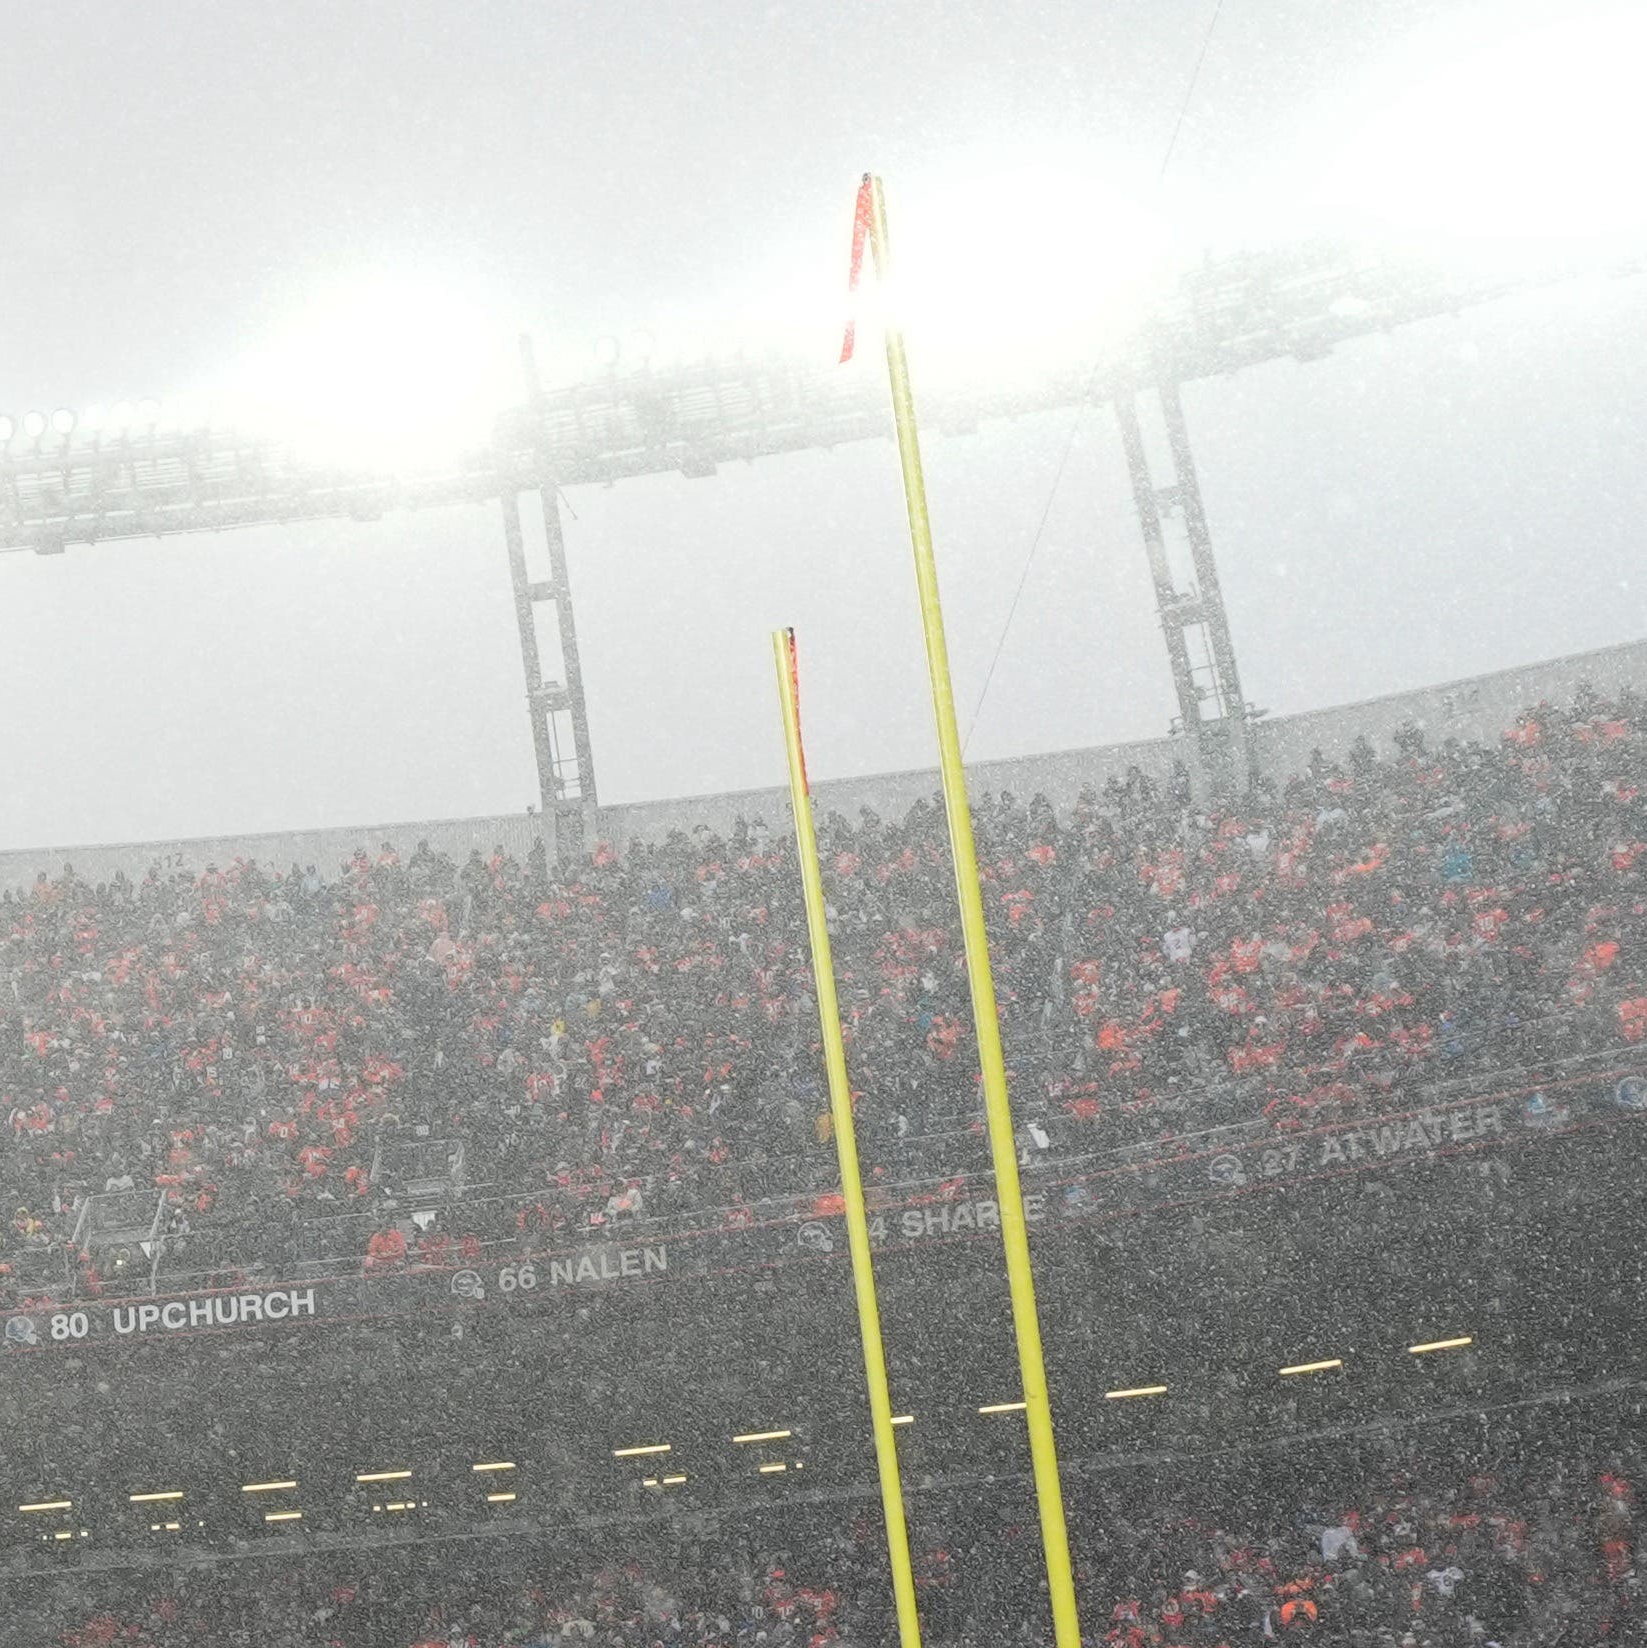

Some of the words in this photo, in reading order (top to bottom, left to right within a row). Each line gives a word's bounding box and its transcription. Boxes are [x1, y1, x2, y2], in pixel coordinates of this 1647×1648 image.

[1322, 1105, 1506, 1166] ATWATER
[902, 1195, 1046, 1237] SHARE
[498, 1264, 537, 1292] 66
[549, 1247, 669, 1286] NALEN
[51, 1313, 89, 1340] 80
[113, 1289, 316, 1335] UPCHURCH
